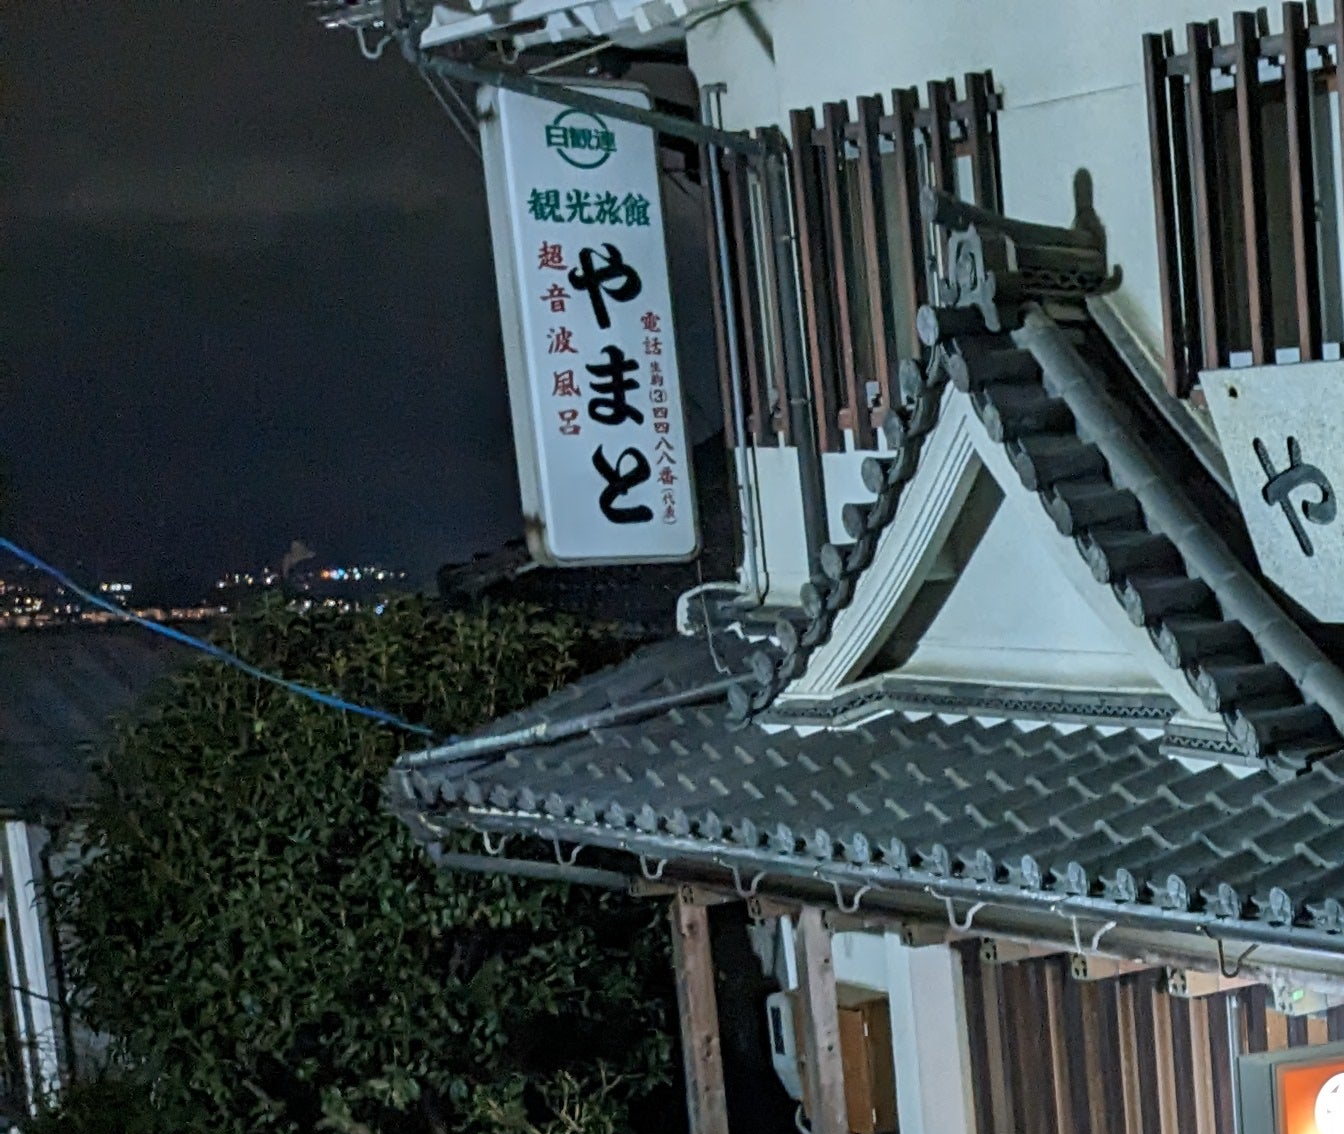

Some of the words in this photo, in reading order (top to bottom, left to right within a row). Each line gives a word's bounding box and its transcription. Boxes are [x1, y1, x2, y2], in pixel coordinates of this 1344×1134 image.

[527, 187, 651, 226] 観光旅館
[537, 241, 581, 436] 超音波風呂
[568, 242, 653, 524] やまと
